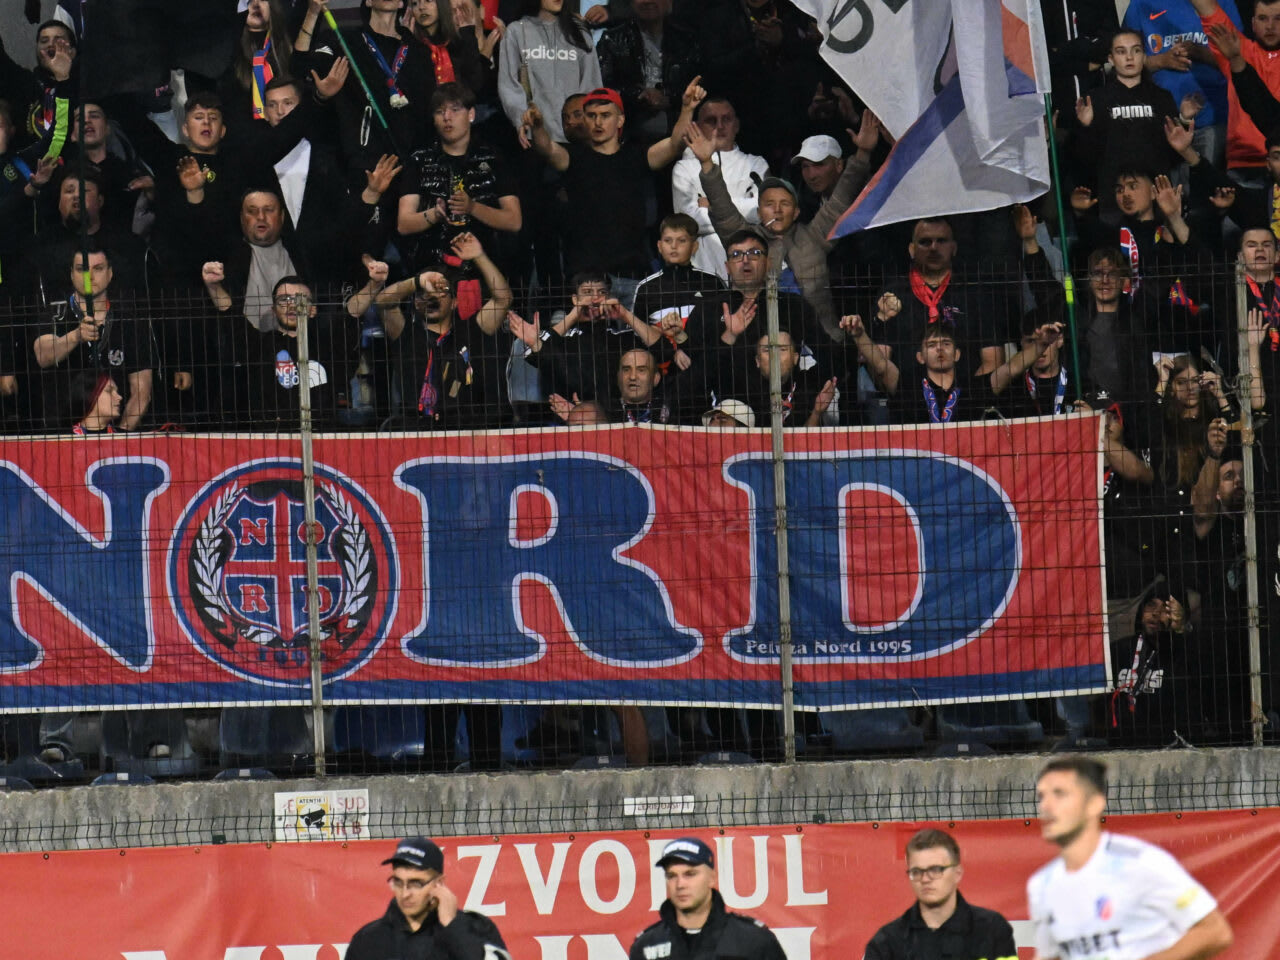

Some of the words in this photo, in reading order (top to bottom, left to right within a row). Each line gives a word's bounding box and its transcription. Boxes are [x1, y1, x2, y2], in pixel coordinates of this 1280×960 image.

[1112, 105, 1153, 119] PUMA
[814, 639, 861, 654] Nord
[869, 639, 912, 653] 1995
[439, 835, 829, 916] ZVOUL
